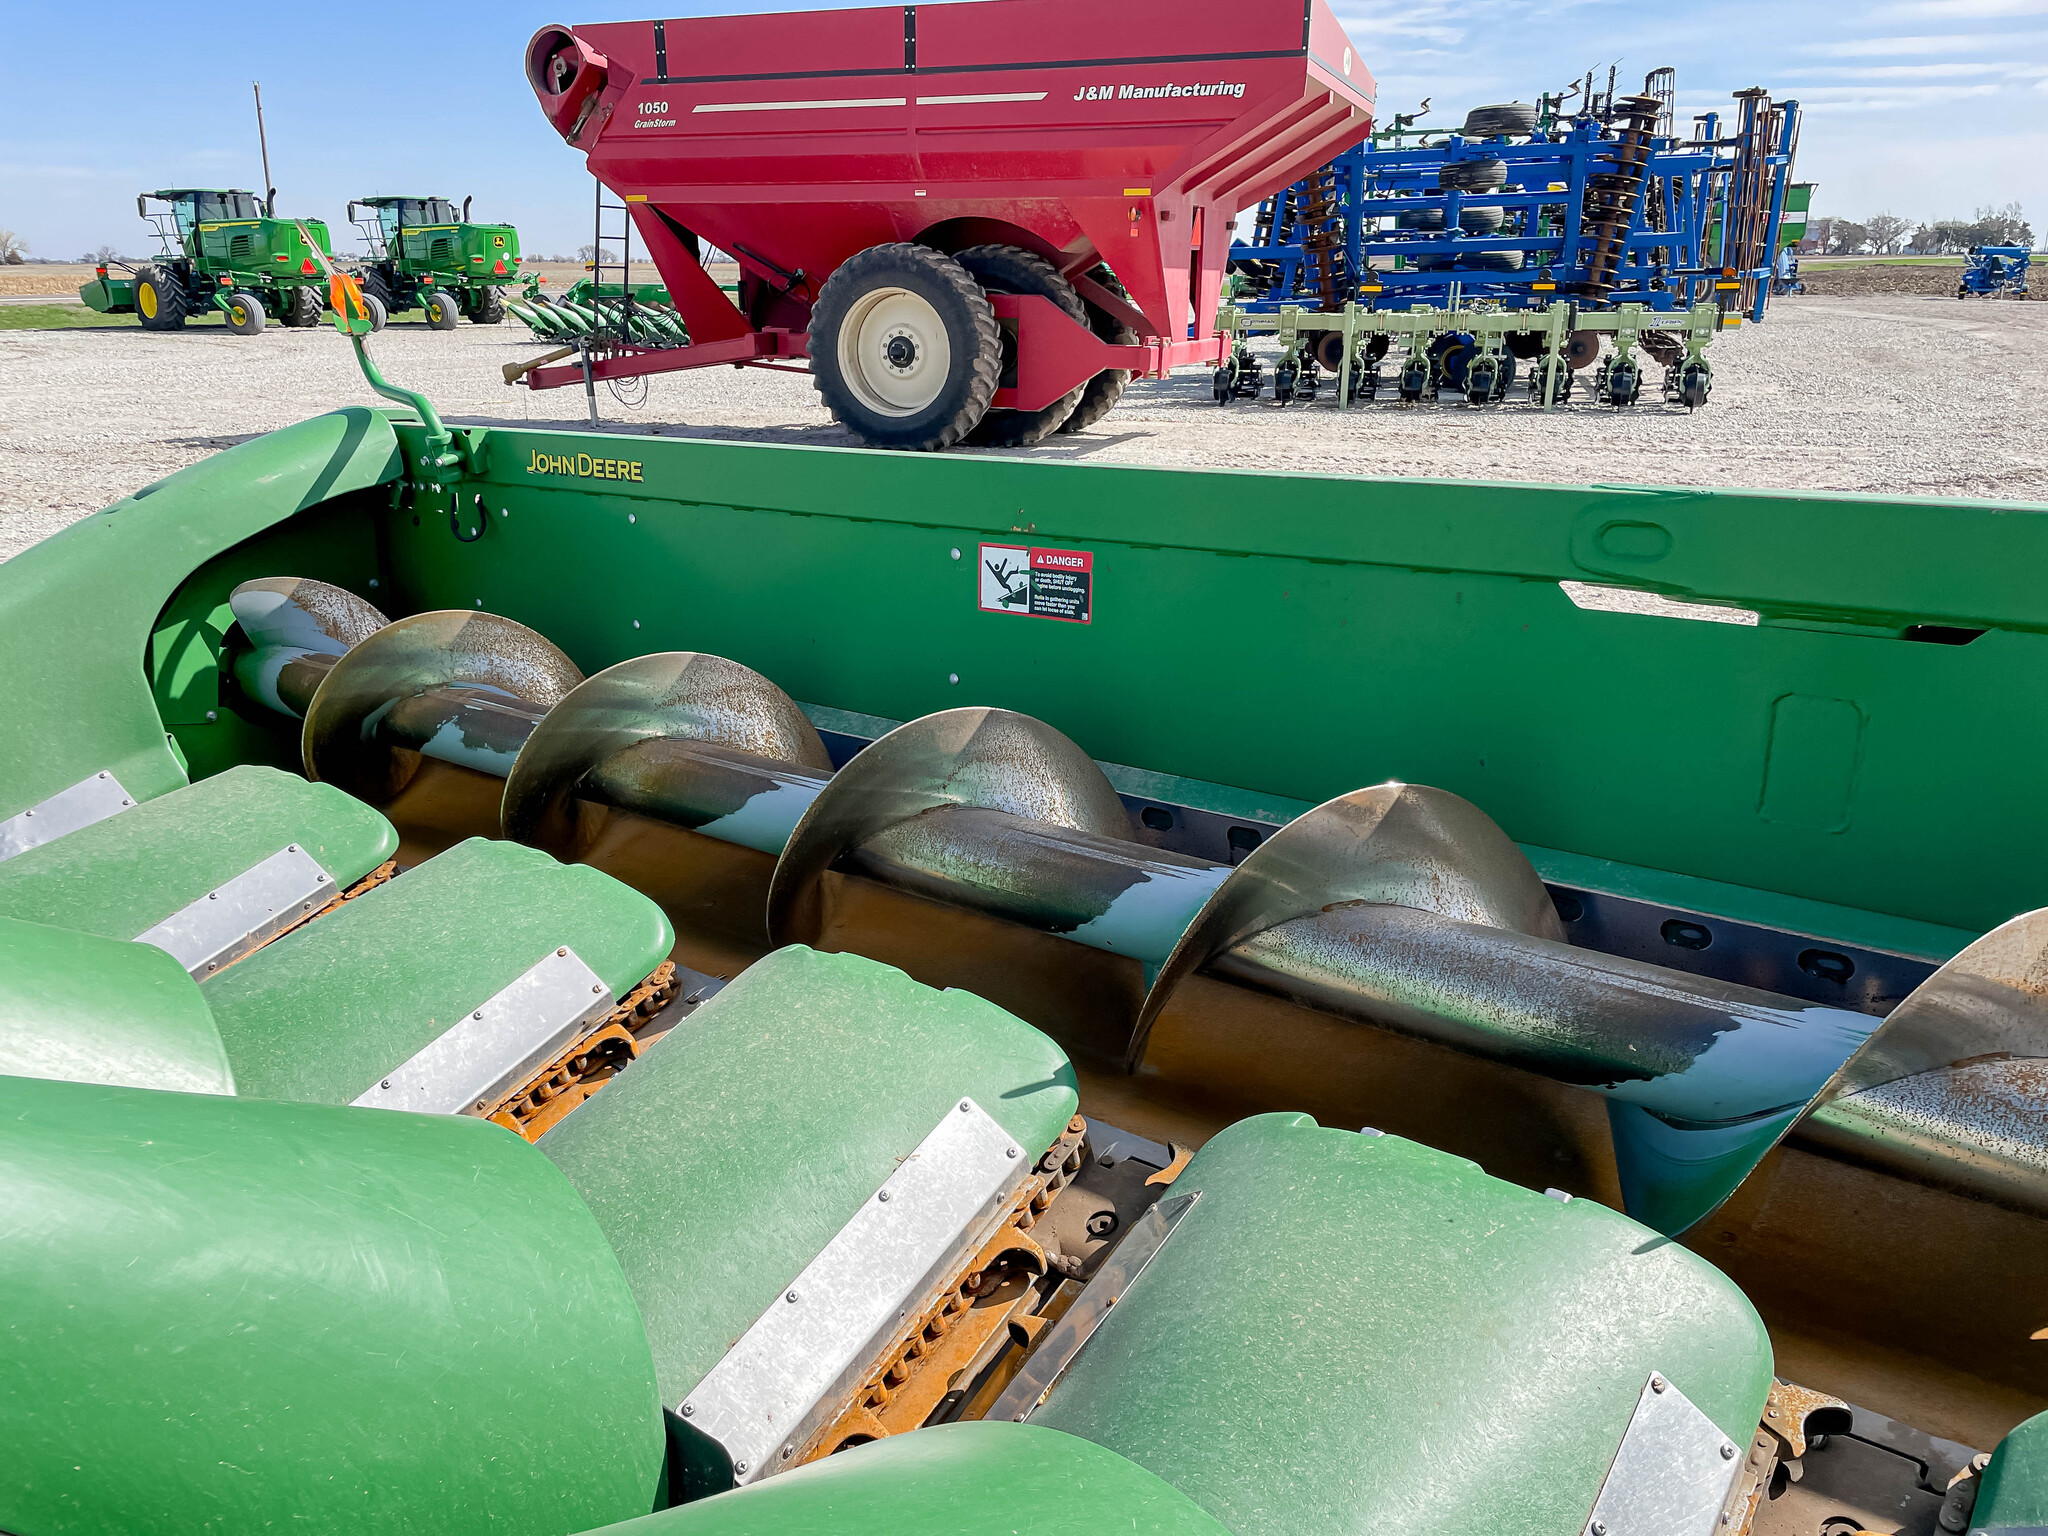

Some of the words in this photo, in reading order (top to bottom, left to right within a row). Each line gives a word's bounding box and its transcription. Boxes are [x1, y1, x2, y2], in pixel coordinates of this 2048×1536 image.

[1073, 85, 1115, 101] J&M
[1118, 81, 1246, 99] Manufacturing
[638, 101, 669, 115] 1050
[634, 118, 677, 129] GrainStorm
[526, 449, 576, 476] JOHN
[577, 452, 644, 482] DEERE
[1046, 555, 1084, 567] DANGER
